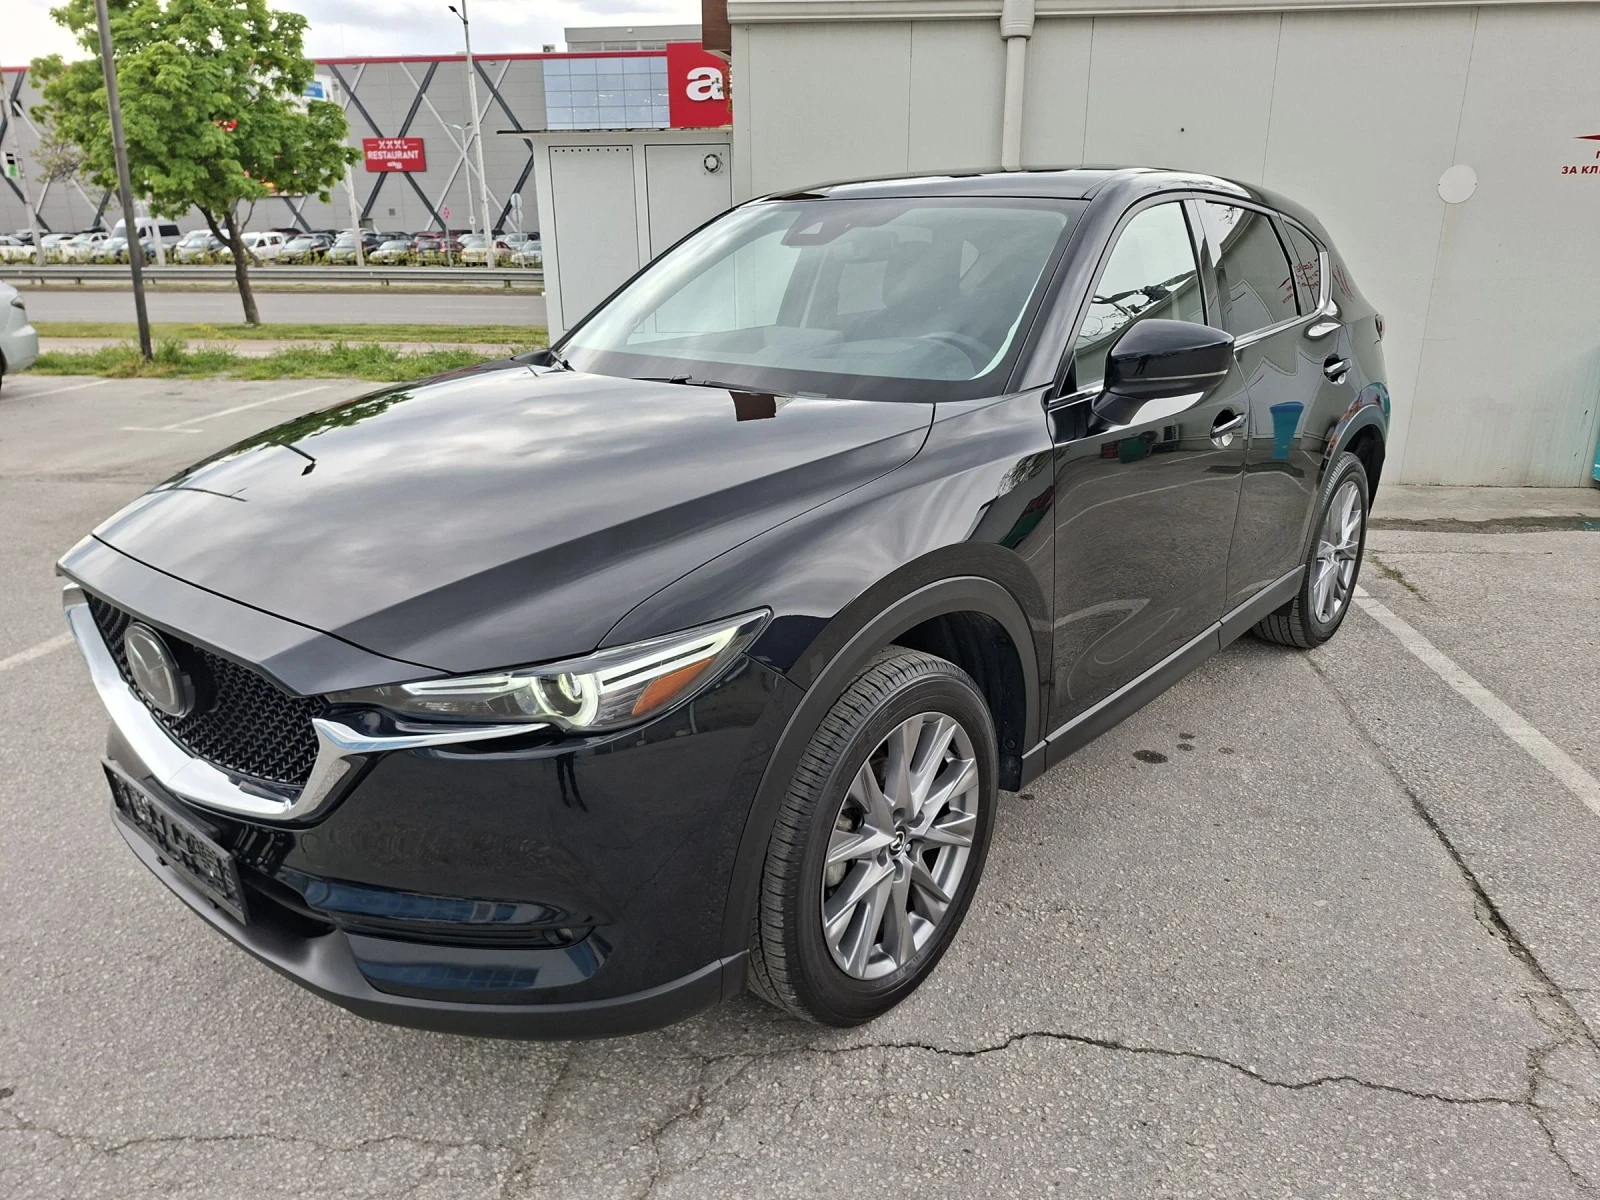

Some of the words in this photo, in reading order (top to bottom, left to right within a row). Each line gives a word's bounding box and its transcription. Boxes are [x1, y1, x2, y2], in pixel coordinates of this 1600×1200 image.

[378, 140, 408, 149] XXXL
[367, 150, 419, 160] RESTAURANT
[1561, 166, 1577, 175] ЗА
[1581, 165, 1600, 174] КЛ
